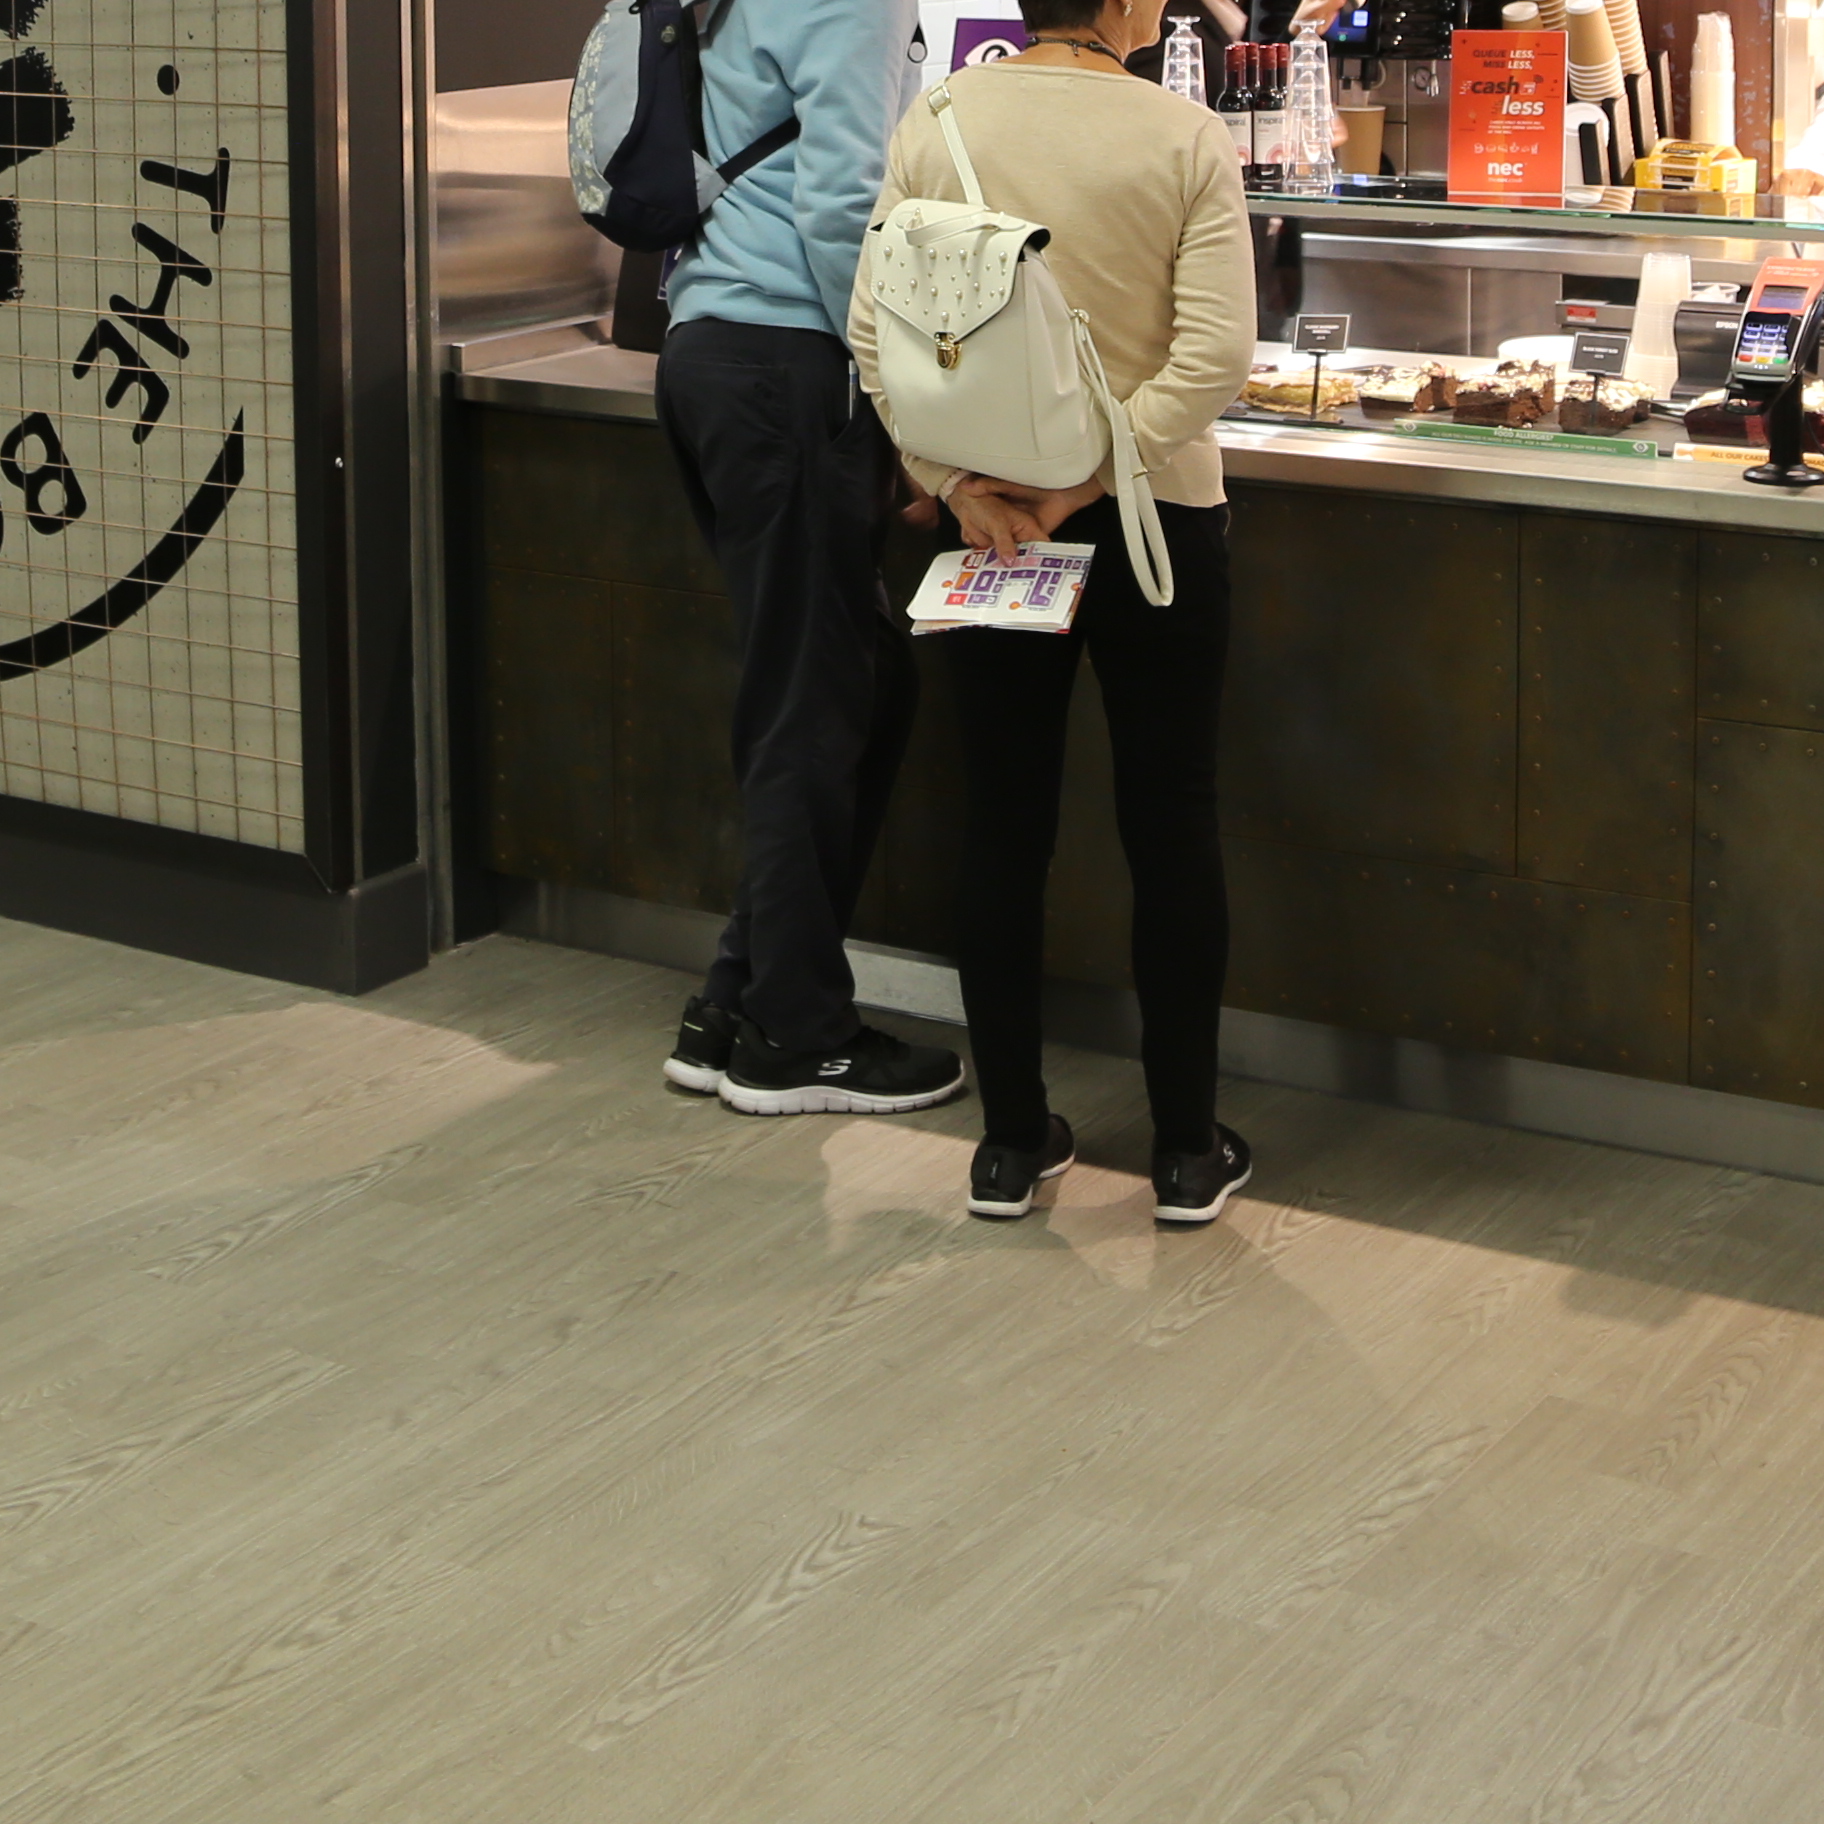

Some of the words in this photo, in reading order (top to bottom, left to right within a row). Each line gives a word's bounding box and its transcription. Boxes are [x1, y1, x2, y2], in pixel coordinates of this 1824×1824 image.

[1473, 50, 1507, 58] QUEUE
[1510, 50, 1535, 59] LESS,
[1508, 60, 1533, 70] LESS,
[1471, 76, 1520, 94] cash
[1502, 95, 1544, 115] less
[1487, 162, 1524, 176] nec
[71, 147, 231, 445] THE
